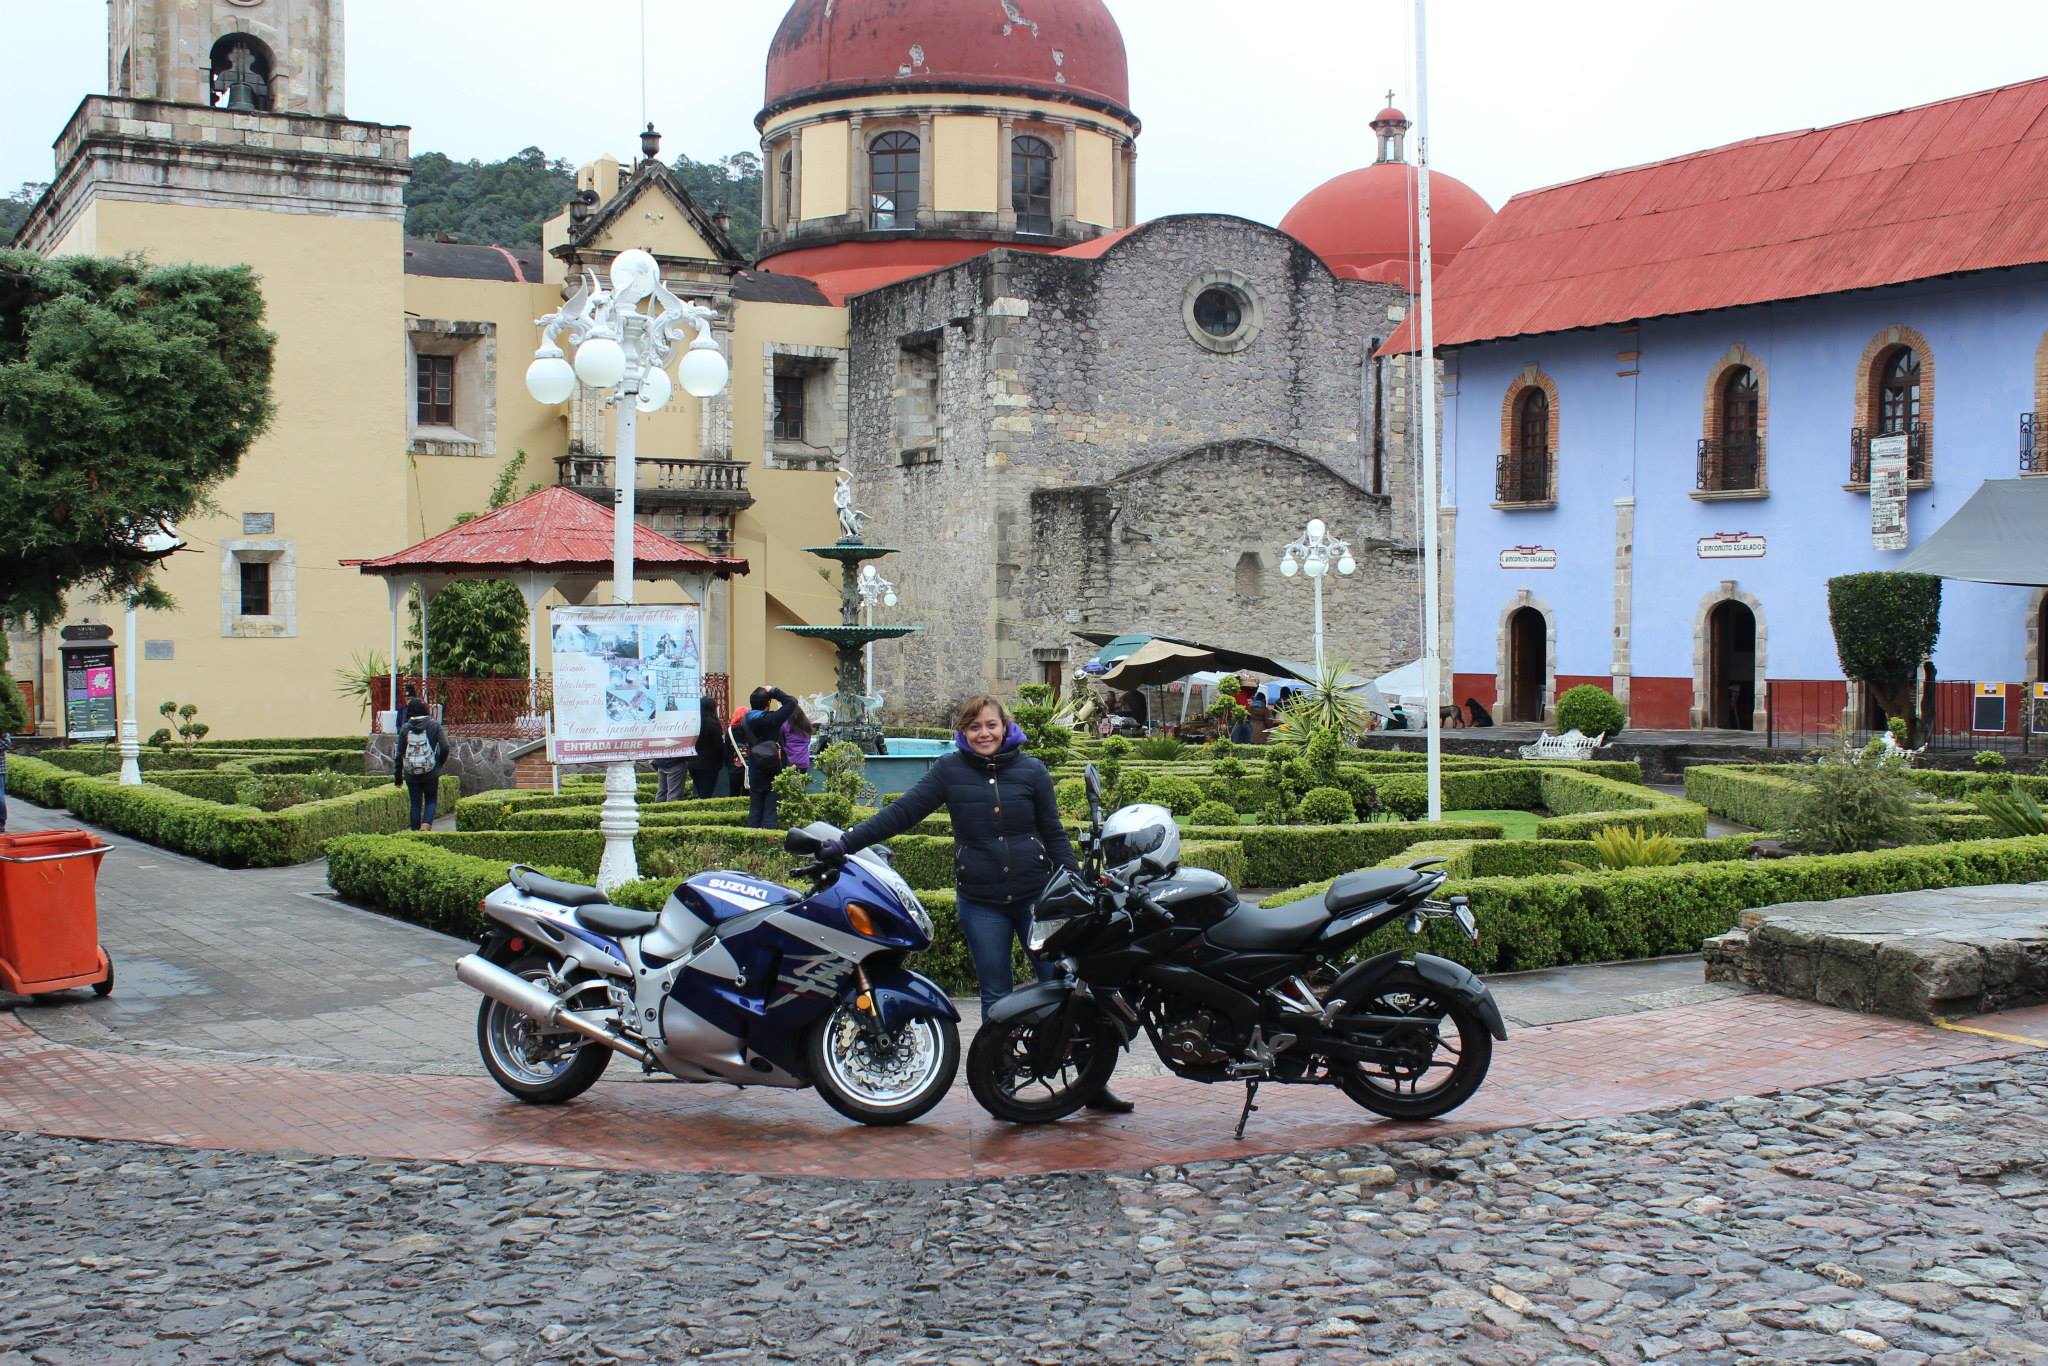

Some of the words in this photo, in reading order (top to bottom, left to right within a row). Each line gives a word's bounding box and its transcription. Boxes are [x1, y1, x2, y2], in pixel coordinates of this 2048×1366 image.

[564, 741, 611, 752] ENTRADA
[615, 741, 644, 750] LIBRE
[708, 878, 768, 900] SUZUKI
